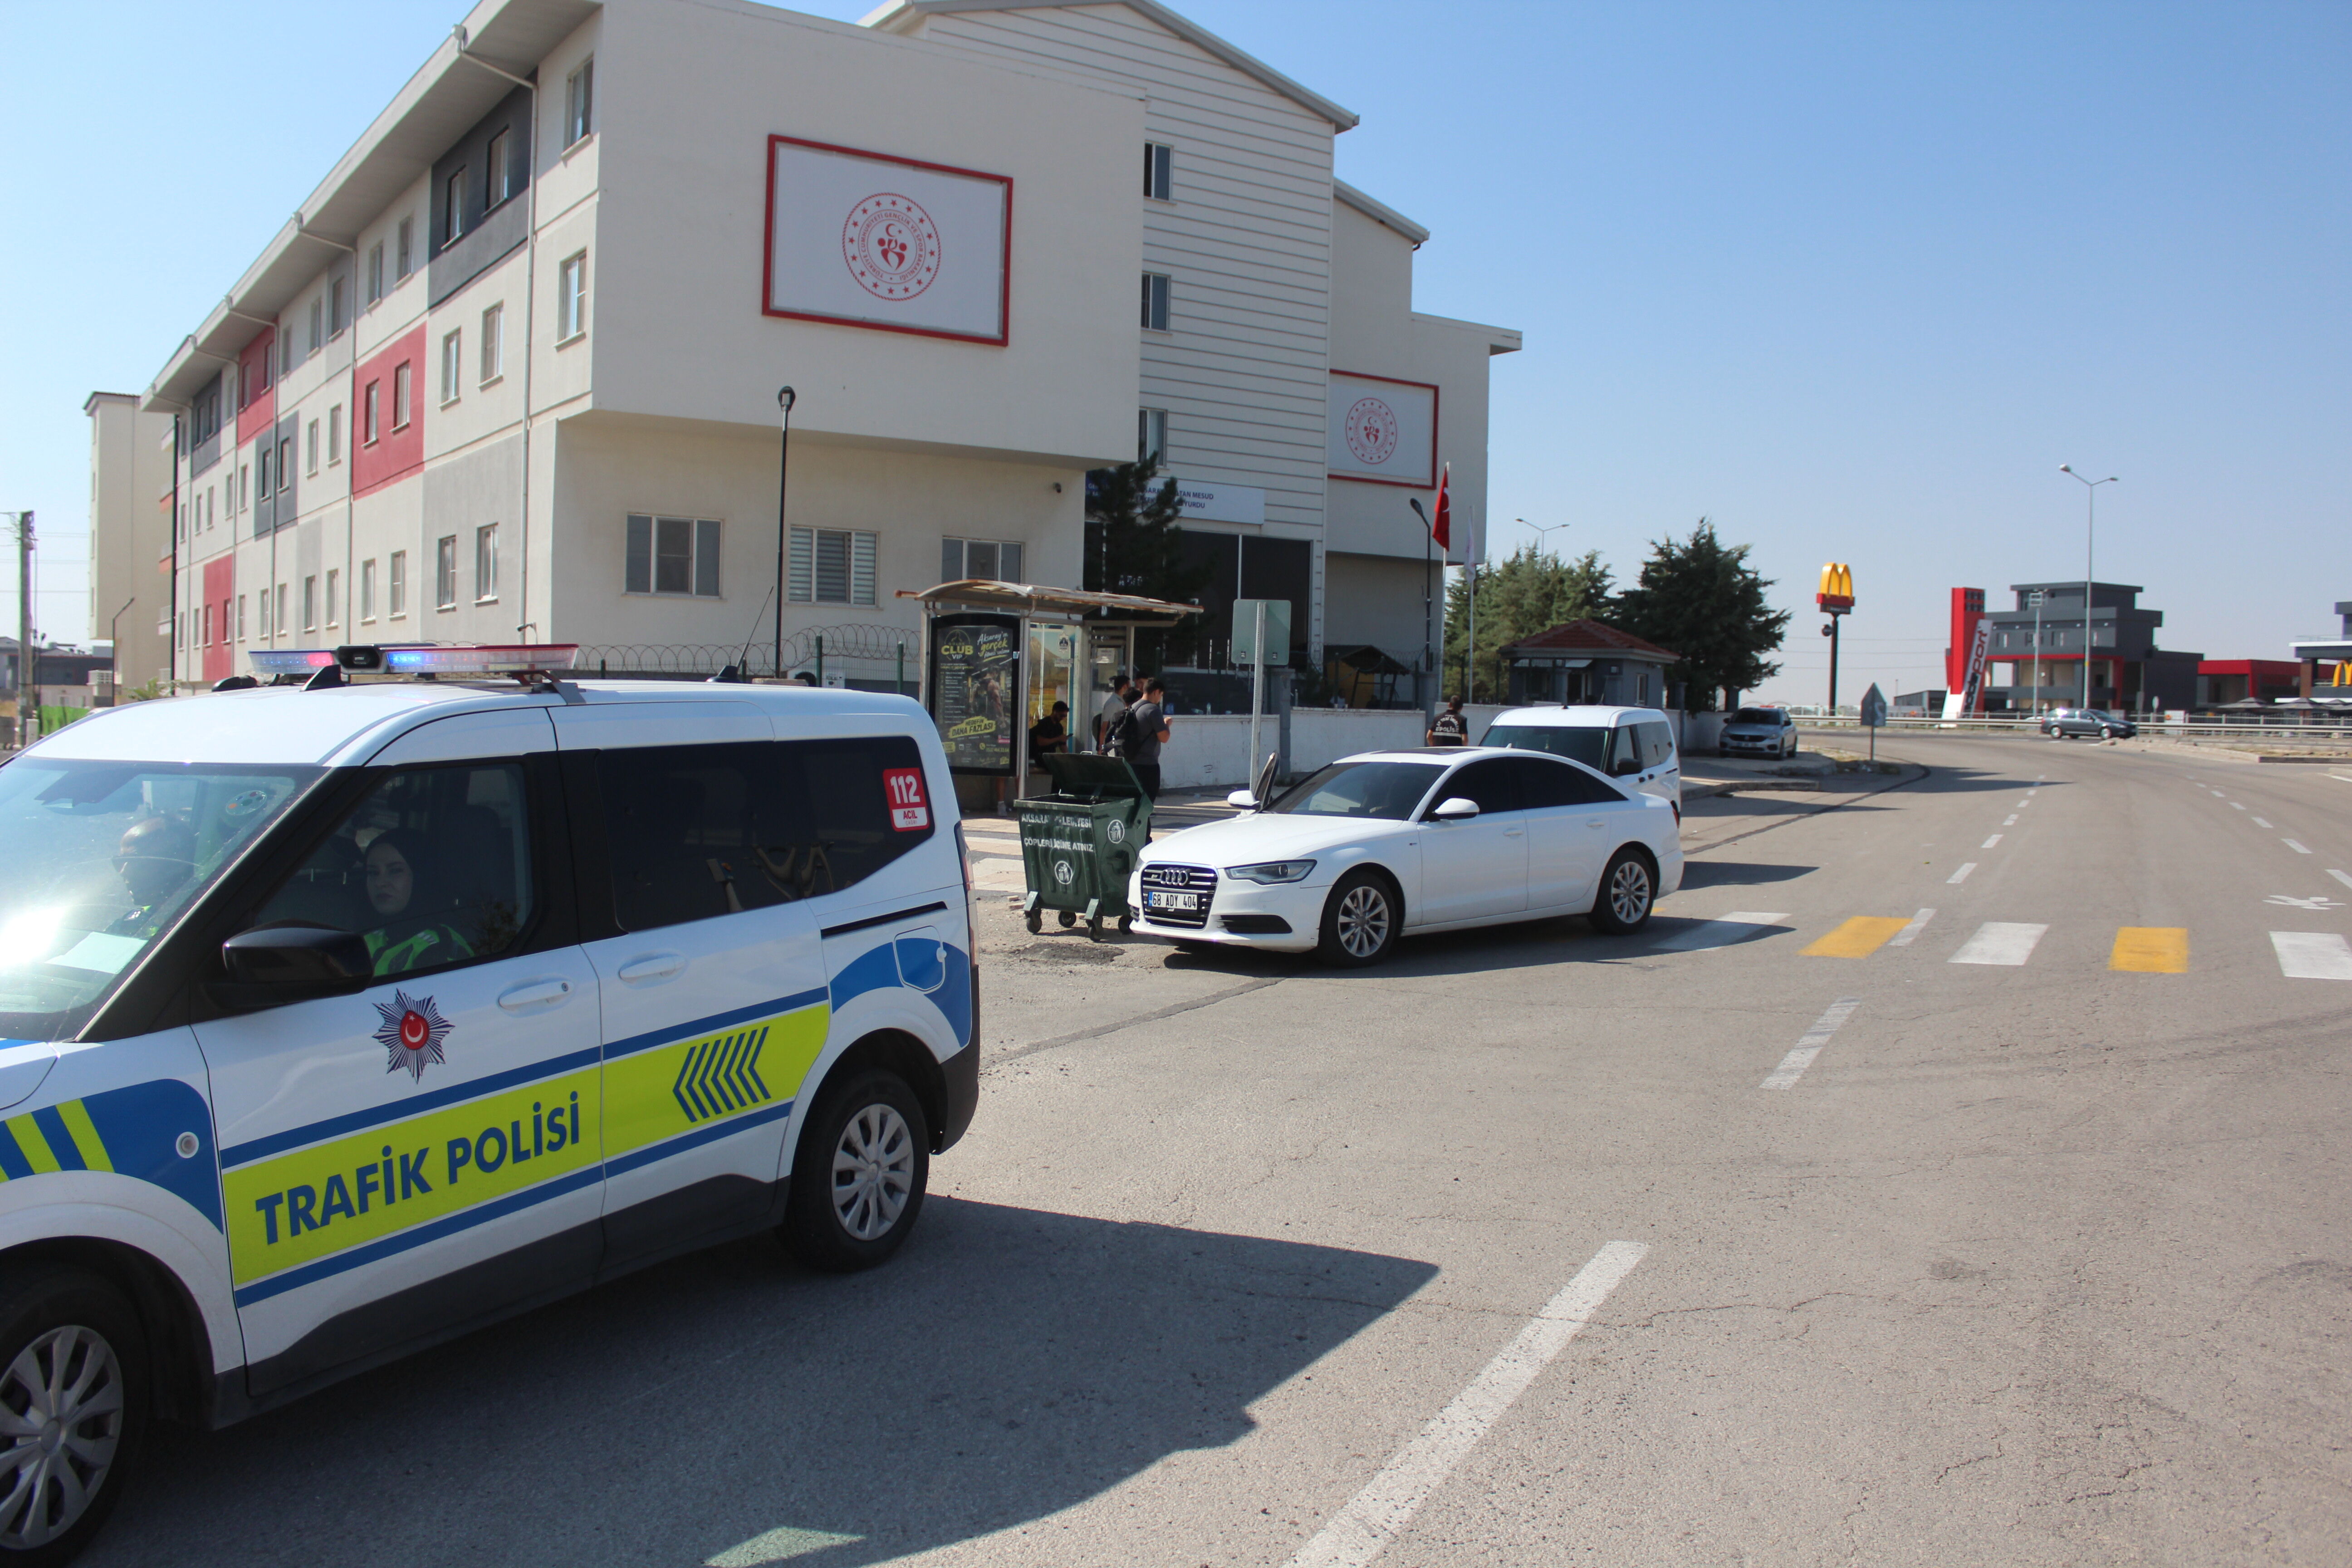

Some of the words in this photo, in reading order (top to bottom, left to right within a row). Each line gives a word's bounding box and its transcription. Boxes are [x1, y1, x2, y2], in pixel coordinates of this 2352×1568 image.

[941, 645, 973, 655] CLUB
[978, 638, 1008, 657] gerçek
[952, 727, 967, 735] DAHA
[969, 722, 993, 733] FAZLASI
[890, 775, 921, 804] 112
[903, 809, 918, 820] ACİL
[1021, 813, 1049, 824] AKSARA
[1073, 842, 1093, 852] ATINIZ
[1153, 894, 1161, 906] 68
[1166, 895, 1178, 907] ADY
[1183, 895, 1196, 908] 404
[255, 1145, 432, 1246] TRAFİK
[446, 1090, 580, 1185] POLİSİ
